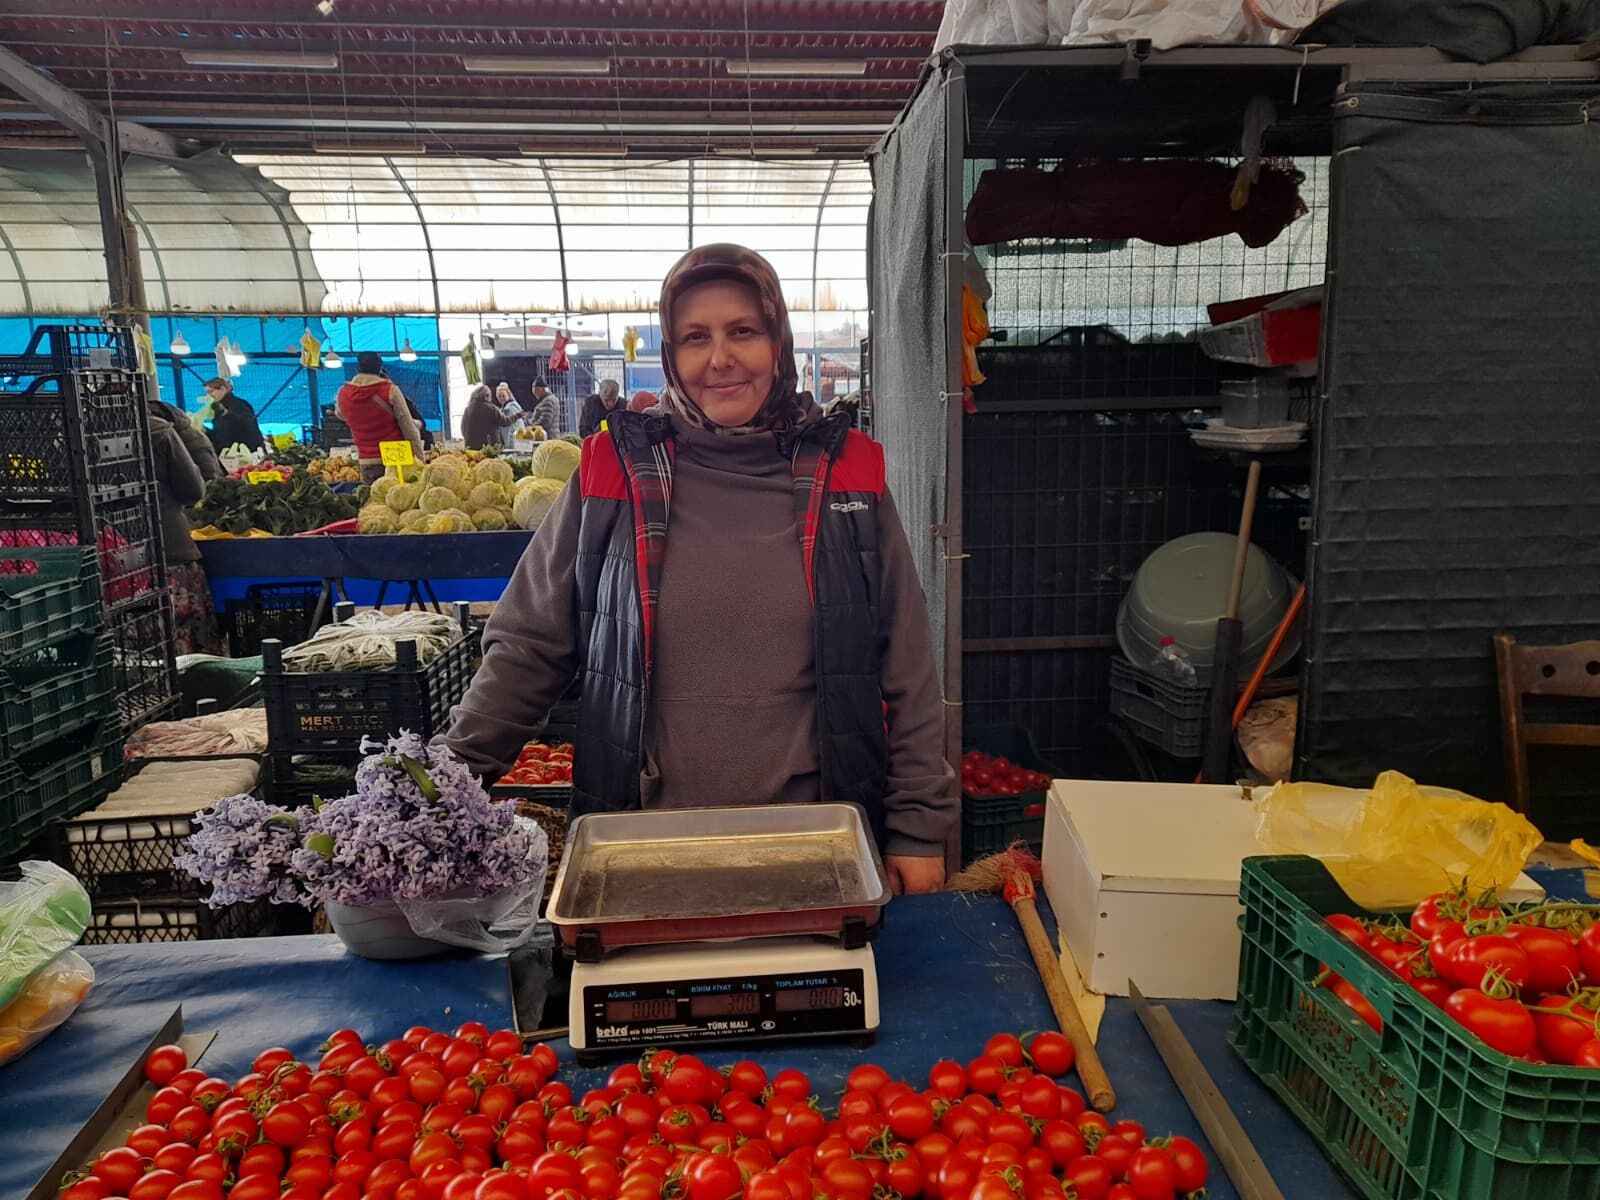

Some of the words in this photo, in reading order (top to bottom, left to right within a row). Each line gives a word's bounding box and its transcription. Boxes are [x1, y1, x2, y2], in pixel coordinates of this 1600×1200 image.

[300, 715, 343, 726] MERT
[776, 980, 805, 988] TOPLAM
[805, 978, 828, 986] TUTAR
[707, 1021, 728, 1030] TÜRK
[730, 1020, 748, 1029] MALI
